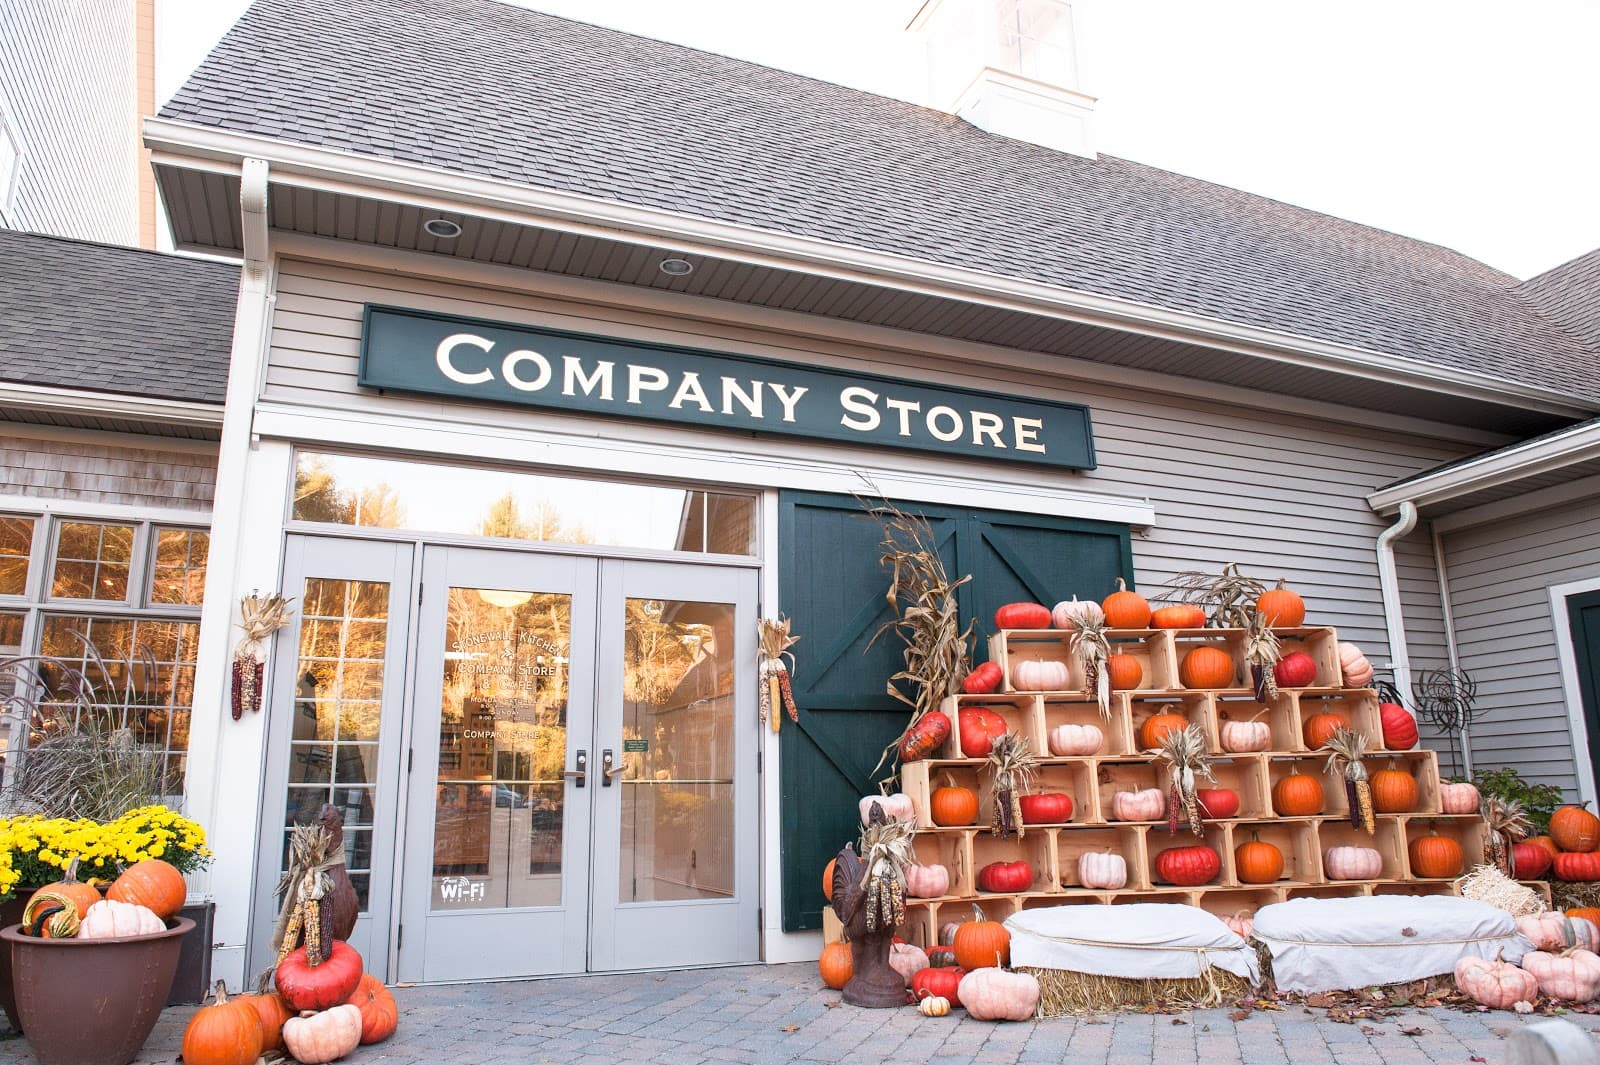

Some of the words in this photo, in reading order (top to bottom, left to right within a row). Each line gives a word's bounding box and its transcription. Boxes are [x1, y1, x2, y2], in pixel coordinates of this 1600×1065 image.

[436, 332, 808, 423] COMPANY
[840, 386, 1046, 455] STORE
[451, 631, 514, 653] STONEWALL
[519, 631, 564, 656] KITCHEN
[457, 662, 513, 675] COMPANY
[518, 664, 556, 676] STORE
[463, 729, 506, 739] COMPANY
[440, 882, 485, 898] Wi-Fi
